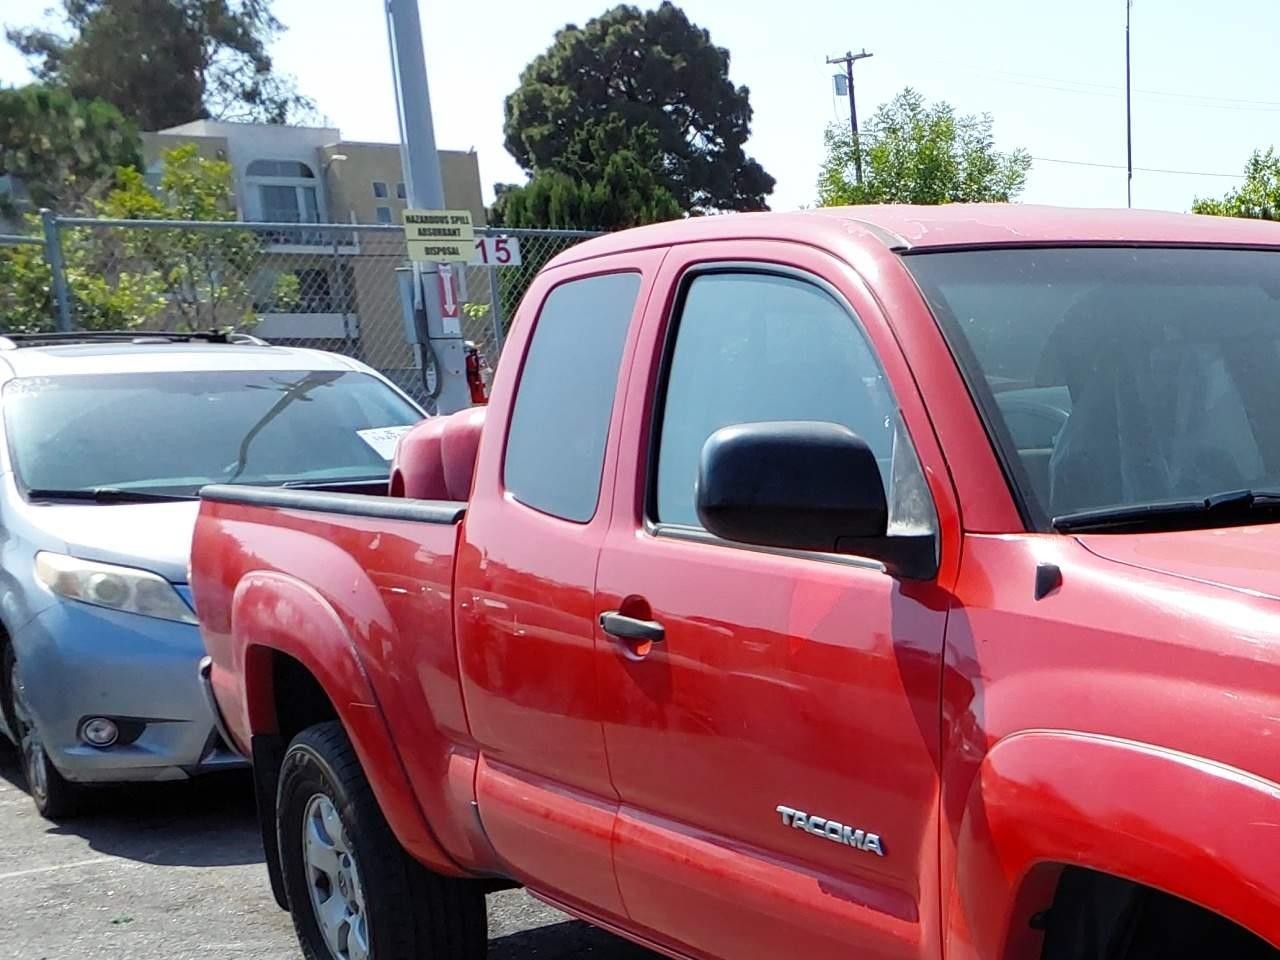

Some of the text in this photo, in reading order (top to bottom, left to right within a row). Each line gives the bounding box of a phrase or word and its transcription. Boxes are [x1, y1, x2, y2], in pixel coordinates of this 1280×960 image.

[405, 215, 470, 224] HAZARDOUS SPILL
[425, 247, 460, 256] DISPOSAL
[475, 239, 511, 264] 15
[776, 805, 884, 857] TACOMA
